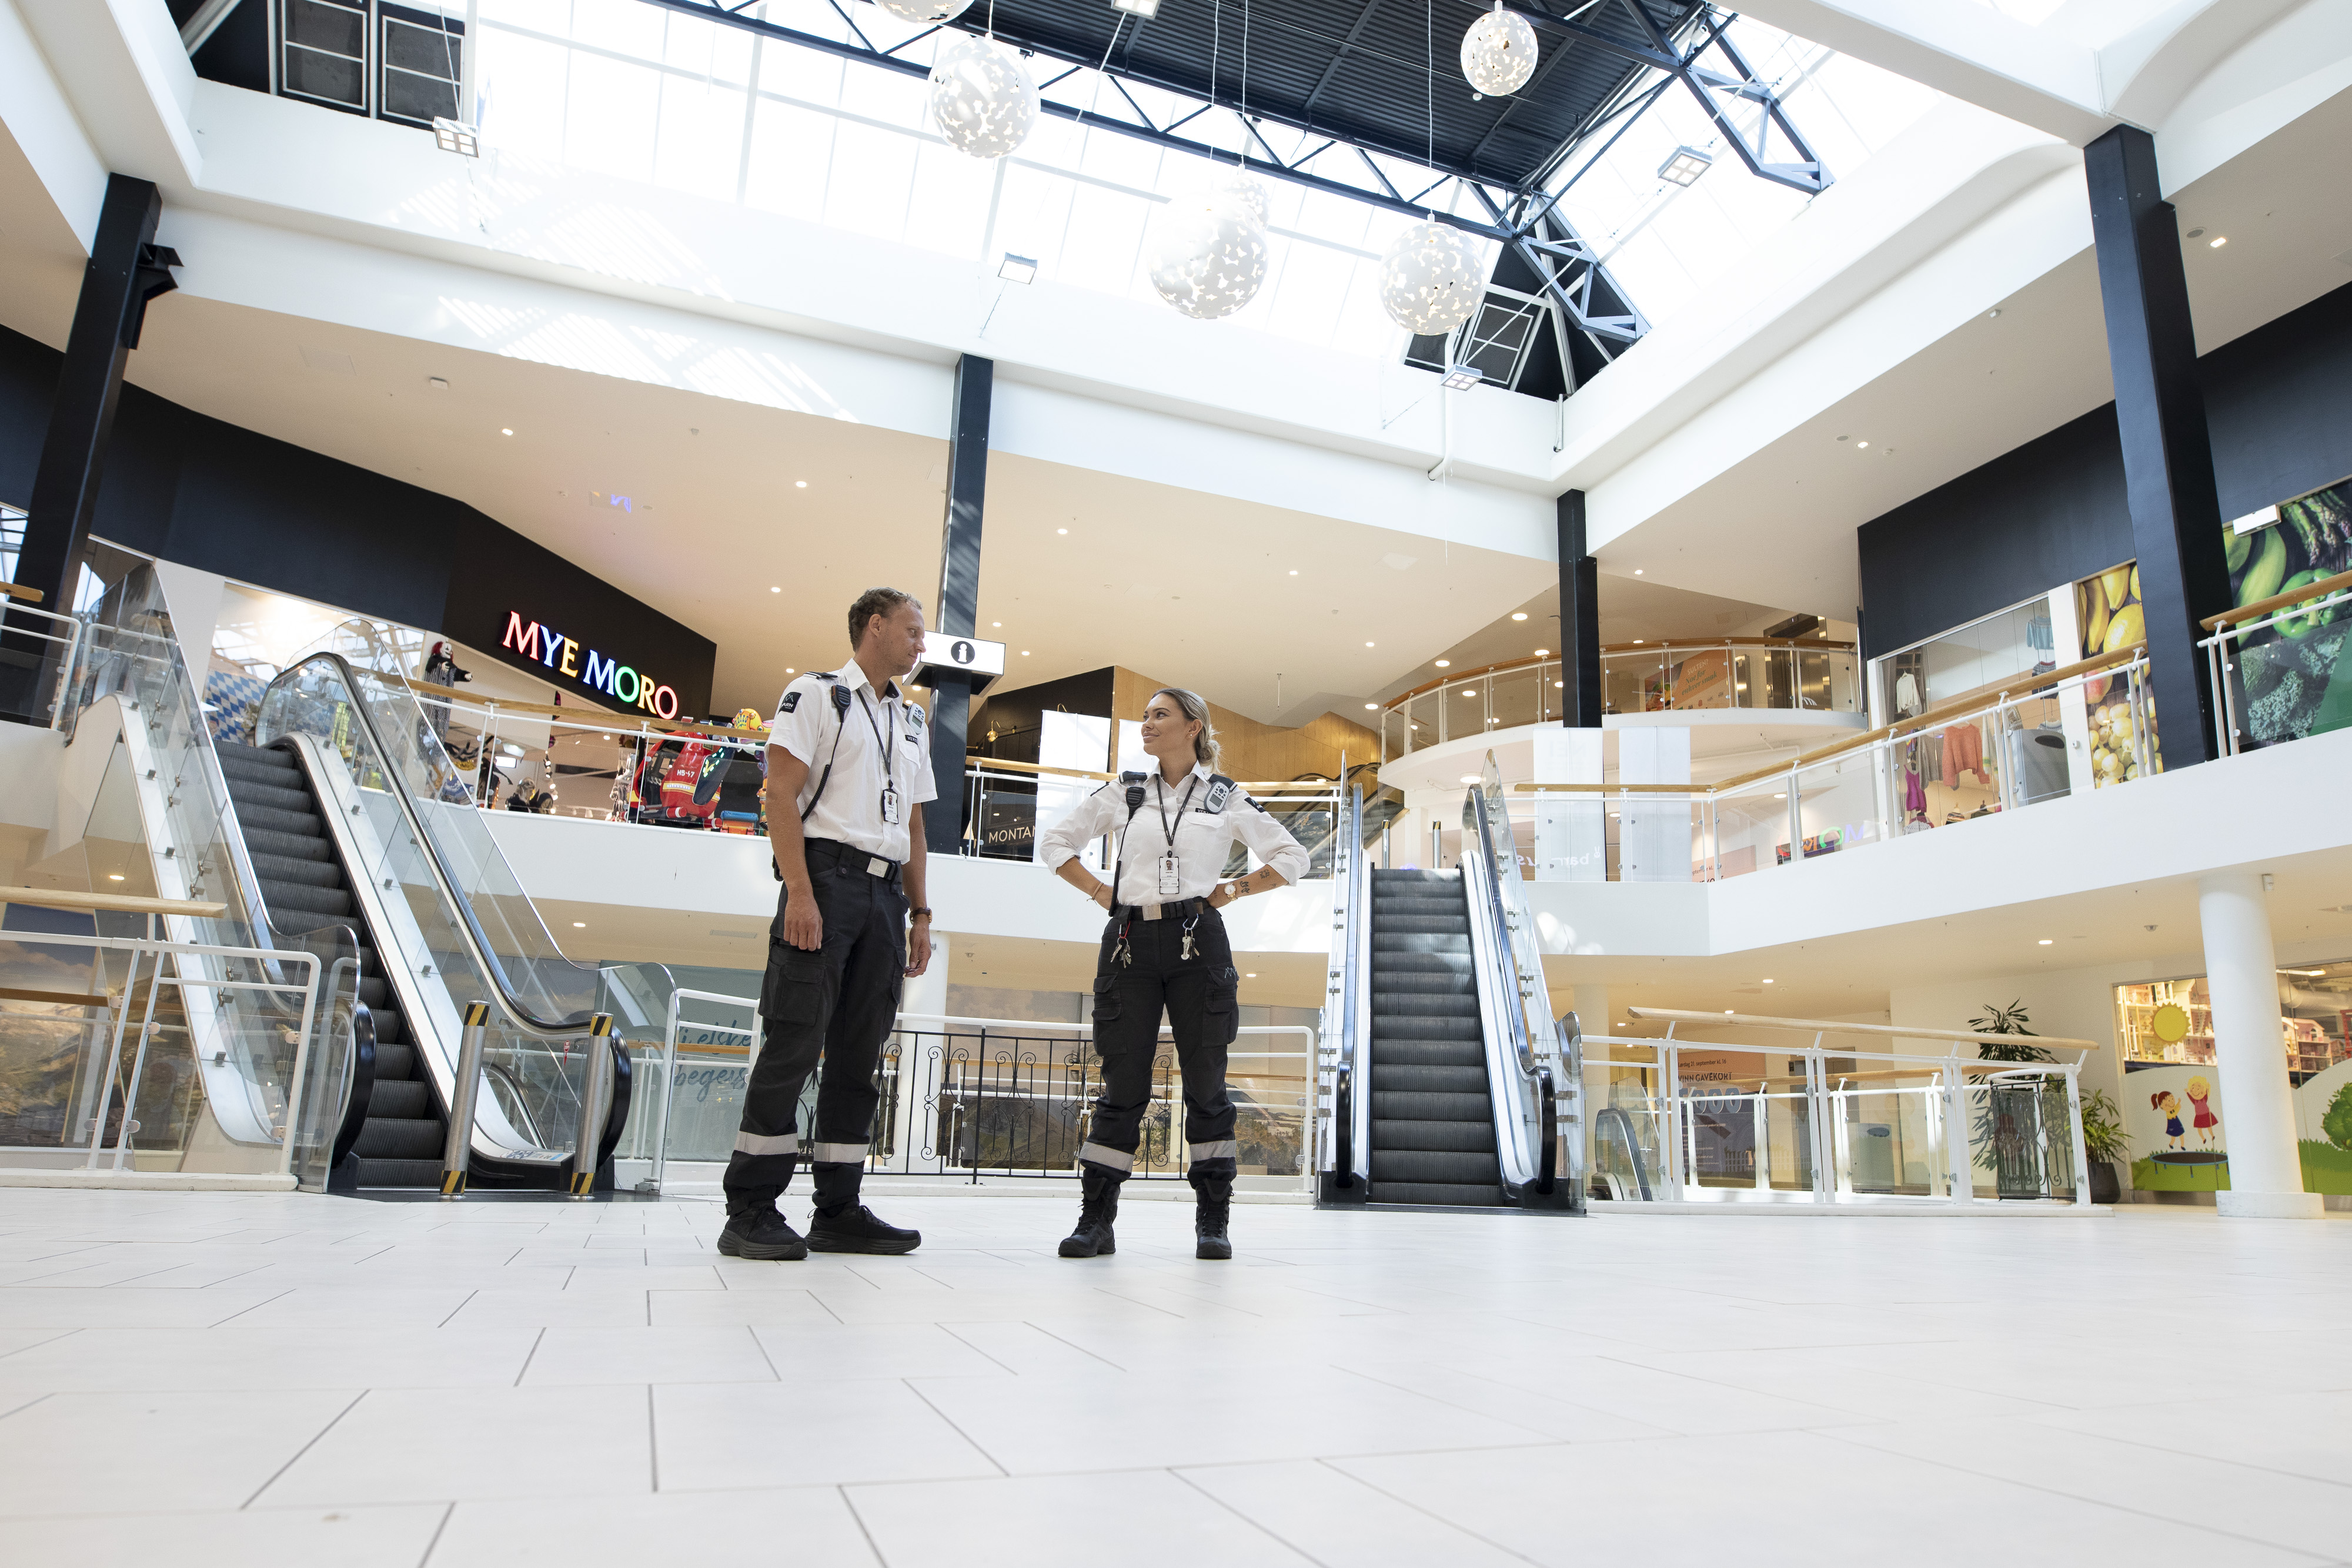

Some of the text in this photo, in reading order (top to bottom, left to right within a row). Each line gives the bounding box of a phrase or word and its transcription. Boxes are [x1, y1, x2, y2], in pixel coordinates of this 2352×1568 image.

[503, 610, 677, 720] MYE MORO
[1687, 658, 1709, 676] SULTEN?
[1682, 671, 1717, 696] enhver smak
[1686, 670, 1706, 684] Noe for
[1696, 1059, 1716, 1067] september
[1678, 1072, 1732, 1082] VINN GAVEKORT
